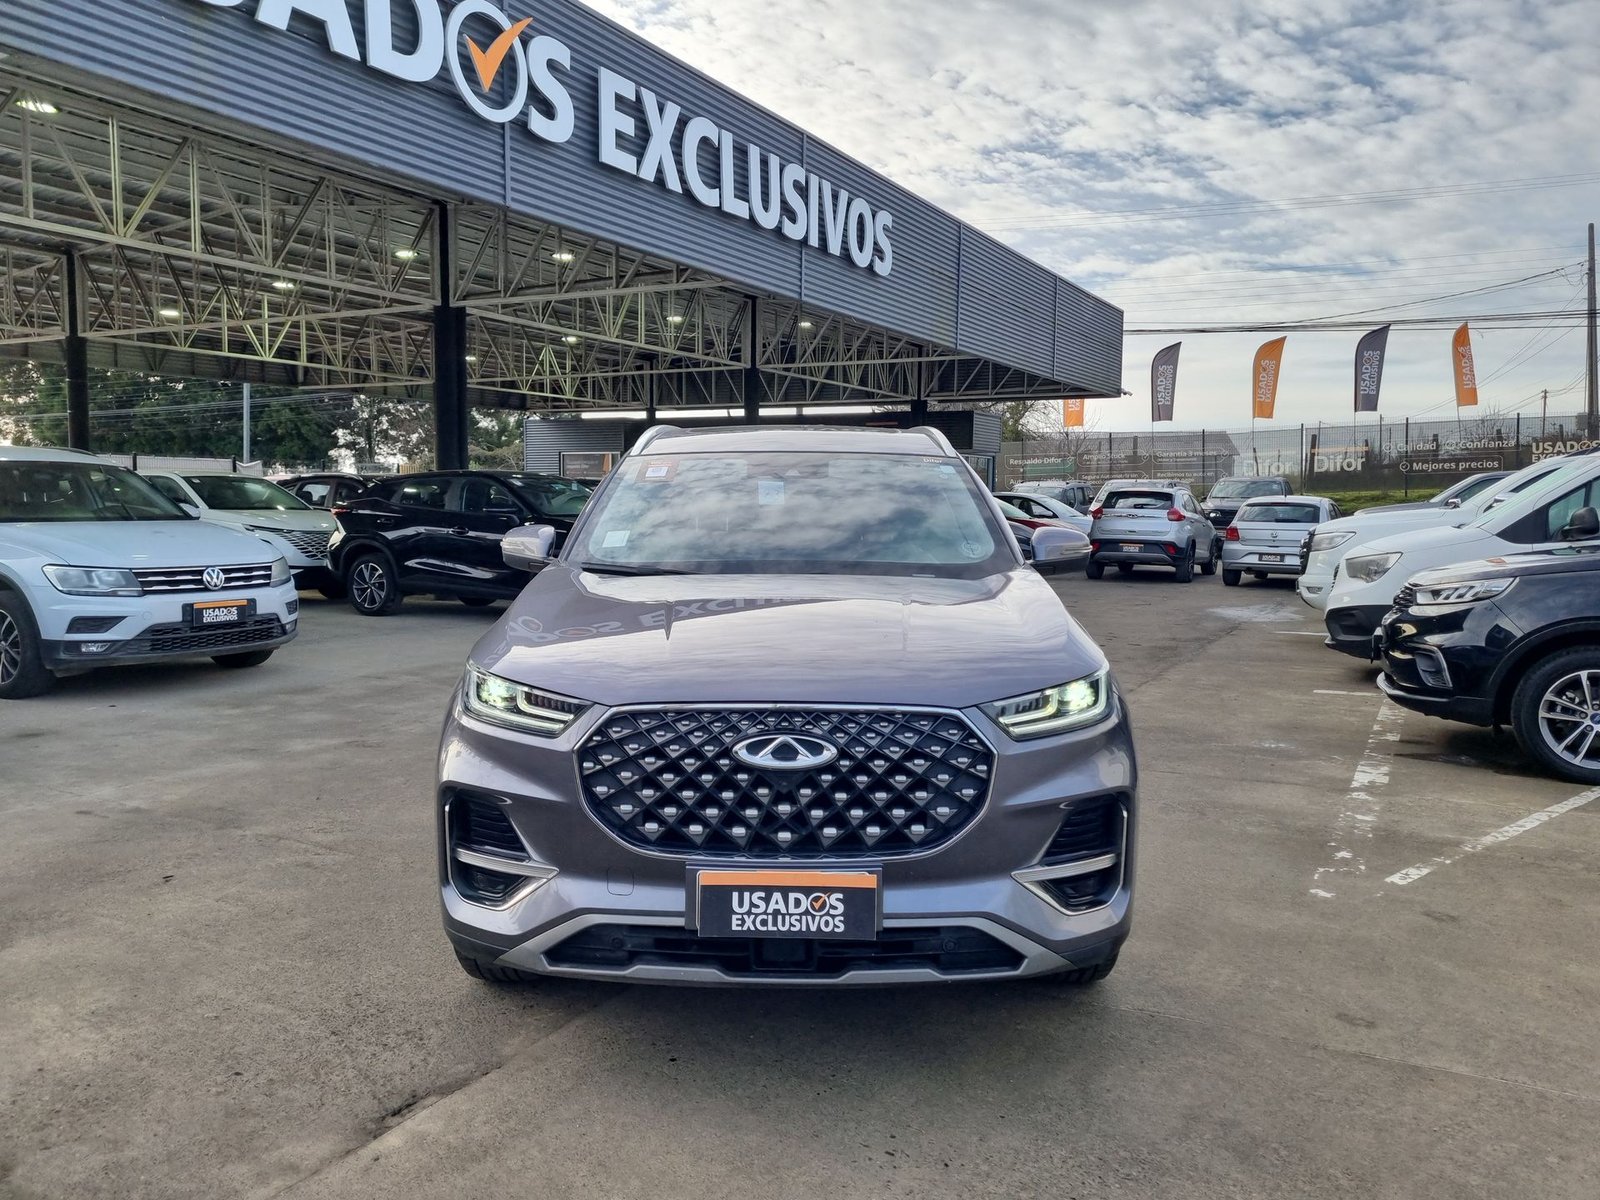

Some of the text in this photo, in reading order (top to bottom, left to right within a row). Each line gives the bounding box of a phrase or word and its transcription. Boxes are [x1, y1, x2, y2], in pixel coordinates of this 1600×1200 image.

[598, 66, 893, 277] EXCLUSIVOS
[1257, 359, 1270, 402] USADOS
[1360, 350, 1373, 395] USADOS
[1369, 350, 1381, 395] EXCLUSIVOS
[1157, 364, 1167, 405] USADOS
[1165, 364, 1174, 405] EXCLUSIVOS
[1460, 439, 1516, 449] Confianza
[1009, 456, 1063, 466] Respaldo Difor
[1314, 455, 1366, 473] Difor
[1412, 460, 1499, 472] Mejores precios
[203, 607, 238, 617] USADOS
[203, 615, 238, 623] EXCLUSIVOS
[731, 891, 844, 916] USADOS
[731, 914, 845, 933] EXCLUSIVOS
